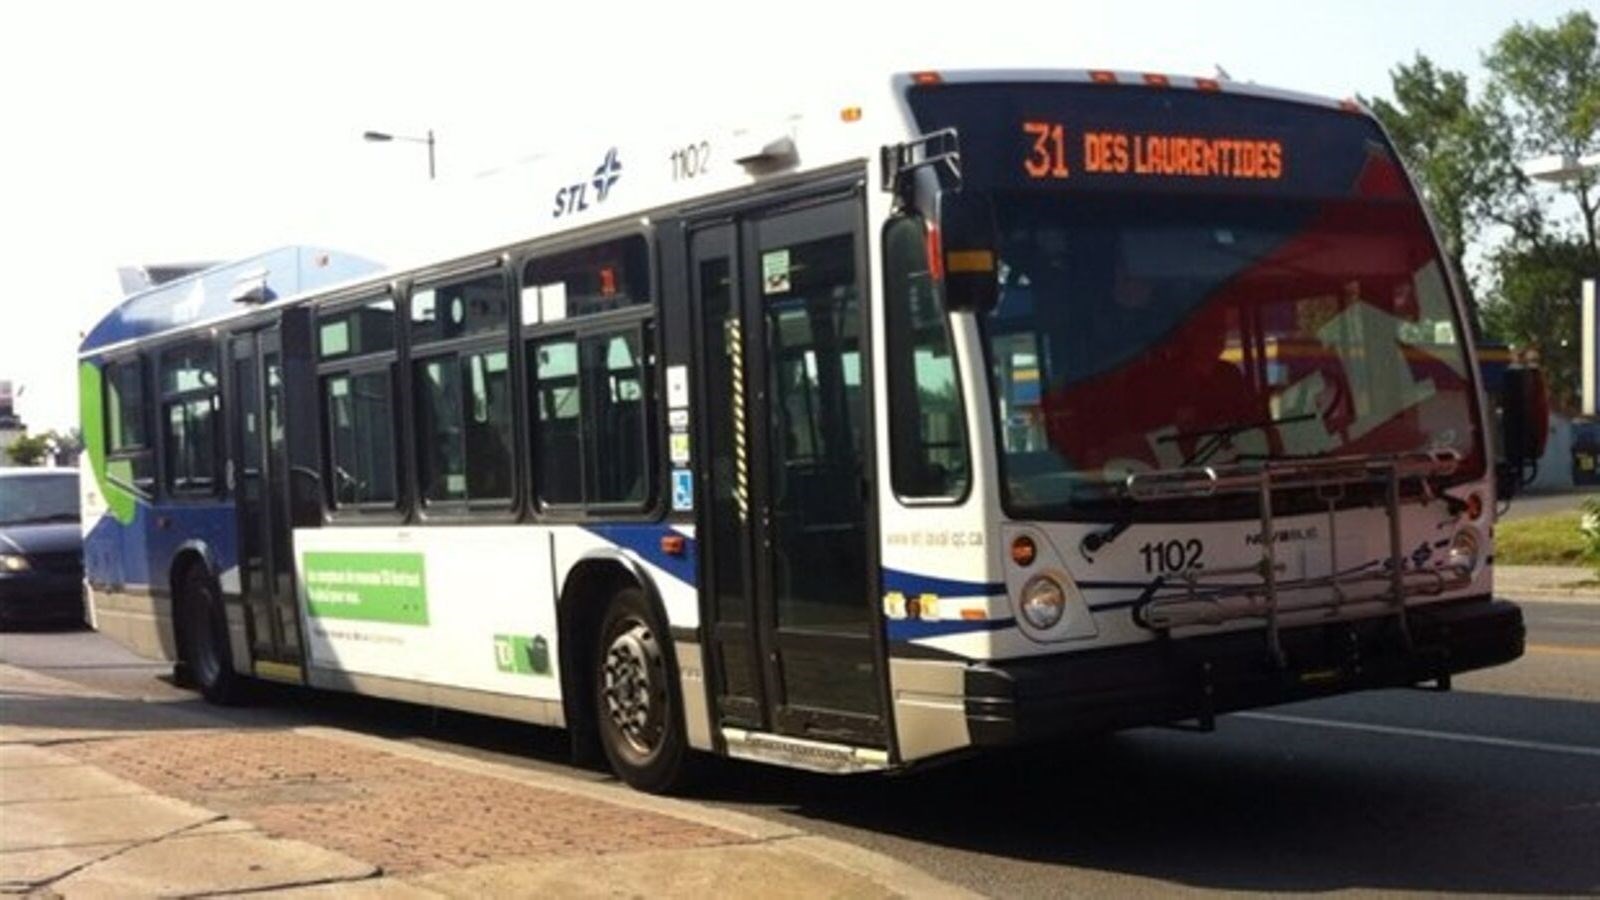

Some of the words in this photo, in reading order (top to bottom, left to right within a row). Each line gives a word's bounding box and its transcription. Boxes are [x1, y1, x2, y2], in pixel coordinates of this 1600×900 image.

[670, 141, 709, 182] 1102
[1024, 122, 1068, 178] 31
[1085, 133, 1128, 173] DES
[1135, 135, 1281, 178] LAURENTIDES
[553, 182, 588, 218] STL
[1139, 538, 1204, 573] 1102
